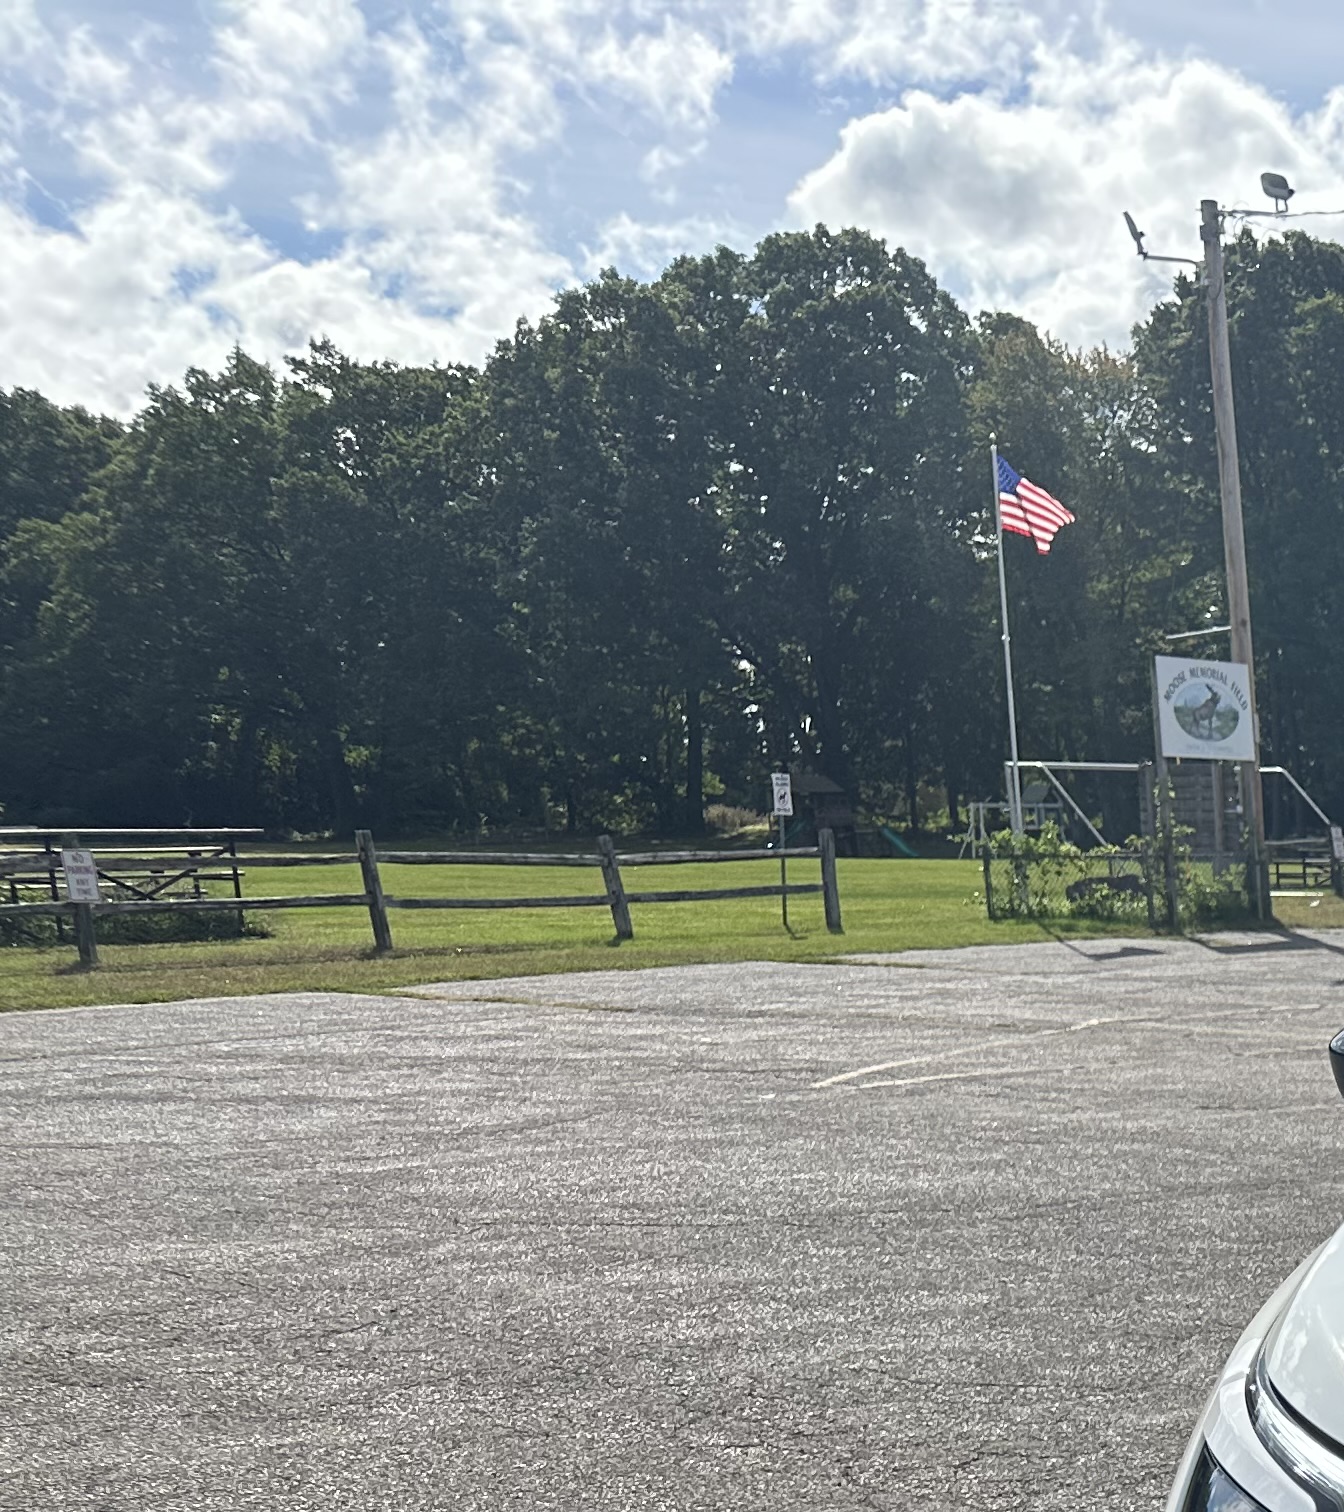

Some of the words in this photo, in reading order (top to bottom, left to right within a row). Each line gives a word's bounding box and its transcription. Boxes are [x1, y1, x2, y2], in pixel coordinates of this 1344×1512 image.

[1164, 670, 1187, 703] MOOSE
[1189, 667, 1228, 685] MEMORIAL
[72, 853, 84, 864] NO
